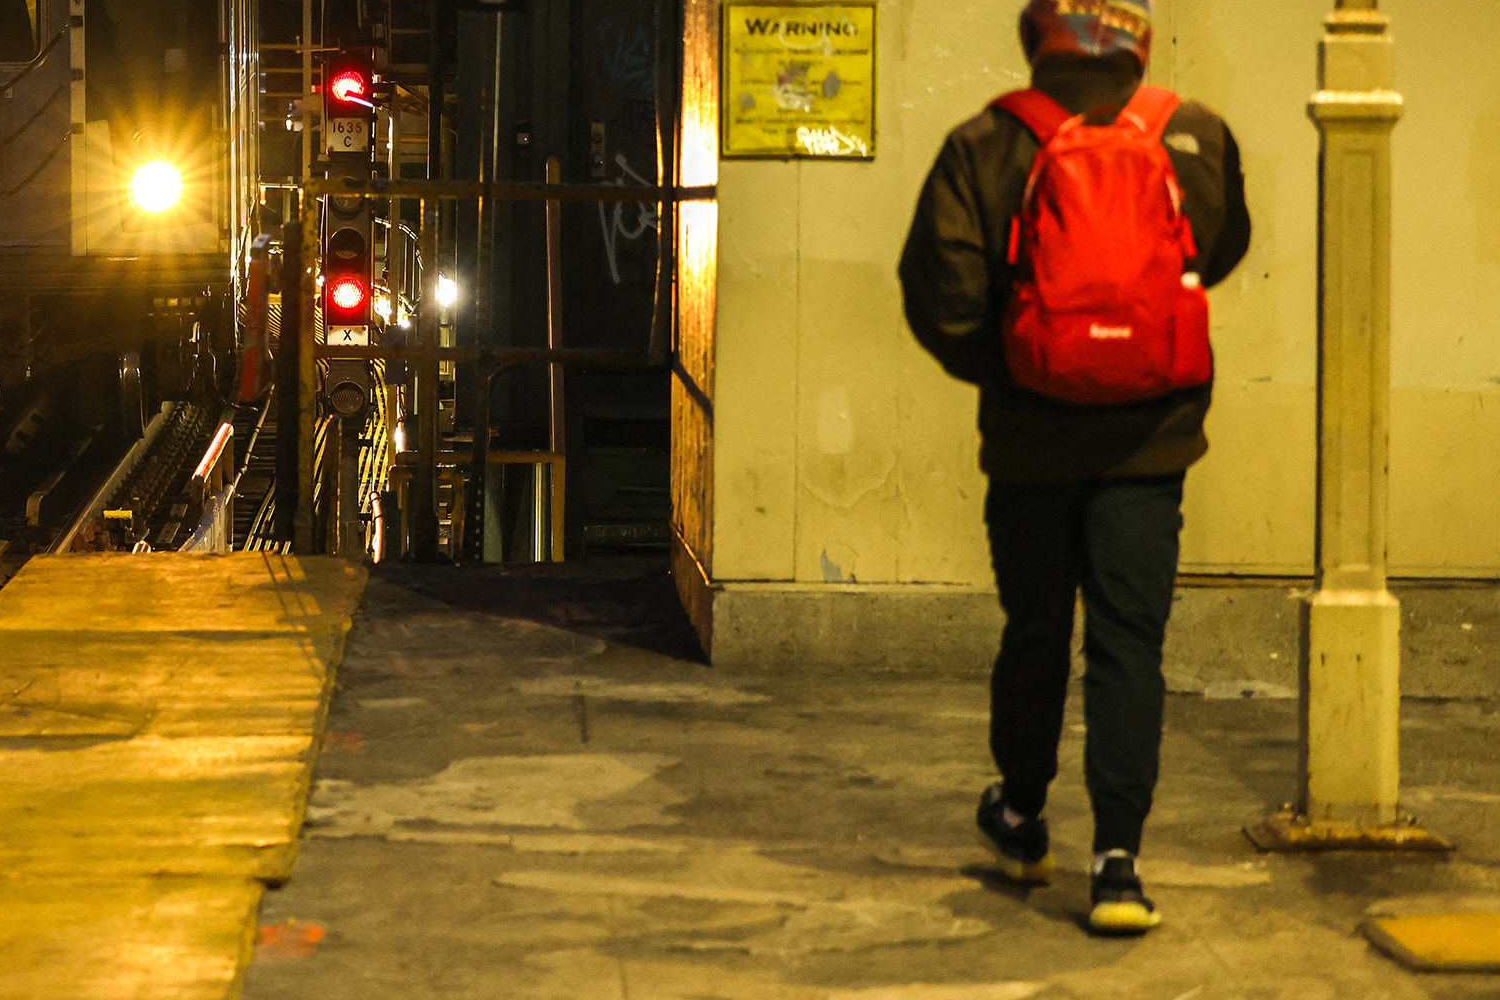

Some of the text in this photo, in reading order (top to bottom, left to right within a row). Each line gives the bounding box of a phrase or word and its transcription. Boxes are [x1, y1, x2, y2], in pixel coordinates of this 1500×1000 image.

[745, 18, 858, 36] WARNING
[333, 122, 363, 134] 1635
[343, 136, 352, 148] C
[343, 329, 352, 341] X
